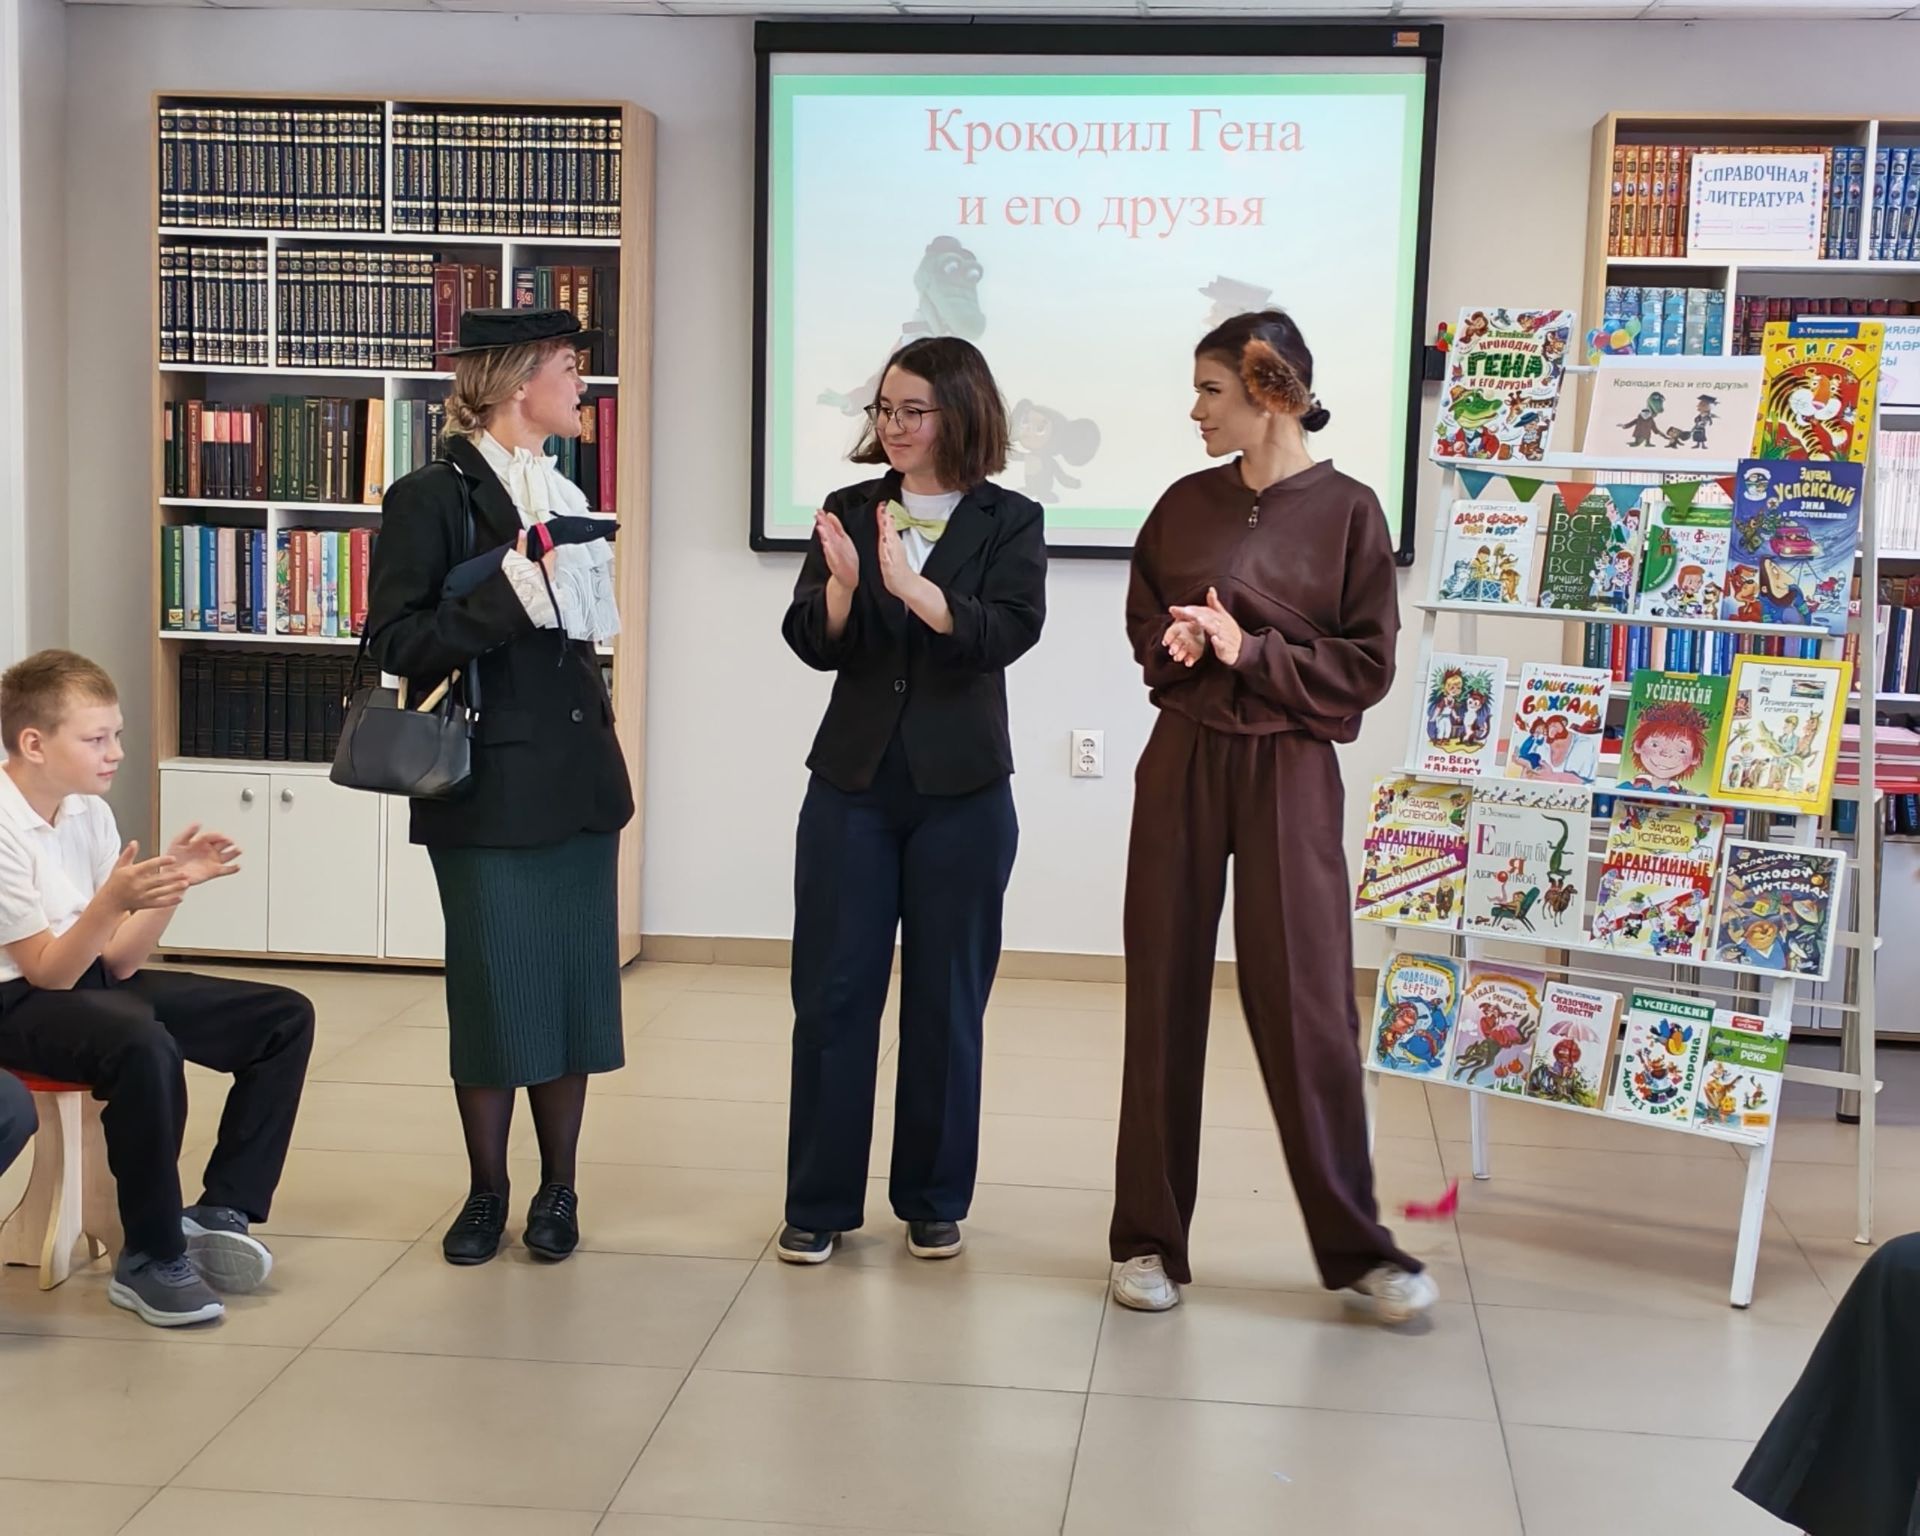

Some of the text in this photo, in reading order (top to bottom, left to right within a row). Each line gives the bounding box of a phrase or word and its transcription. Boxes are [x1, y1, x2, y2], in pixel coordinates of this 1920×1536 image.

[924, 108, 1305, 164] Крокодил Гена
[1704, 165, 1809, 183] СПРАВОЧНАЯ
[1704, 190, 1805, 207] ЛИТЕРАТУРА
[958, 196, 1267, 238] и его друзья
[1479, 340, 1540, 353] КРОКОДИЛ
[1787, 343, 1854, 358] ТИГР
[1467, 351, 1544, 378] ГЕНА
[1470, 379, 1533, 390] И ЕГО ДРУЗЬЯ
[1613, 379, 1661, 388] Крокодил
[1696, 382, 1711, 390] его
[1773, 482, 1856, 507] УСПЕНСКИЙ
[1800, 501, 1825, 510] ЗИМА
[1547, 574, 1584, 584] ЛУЧШИЕ
[1527, 678, 1605, 696] ВОЛШЕБНИК
[1645, 682, 1713, 705] УСПЕНСКИЙ
[1522, 695, 1599, 718] БАХРАМ
[1428, 755, 1480, 766] ПРО ВЕРУ
[1433, 763, 1482, 775] АНФИСУ
[1398, 808, 1447, 822] УСПЕНСКИЙ
[1372, 827, 1466, 849] ГАРАНТИЙНЫЕ
[1637, 833, 1689, 847] УСПЕНСКИЙ
[1378, 842, 1442, 858] ЧЕЛОВЕЧКИ
[1610, 850, 1711, 877] ГАРАНТИЙНЫЕ
[1368, 853, 1457, 898] ВОЗВРАЩАЮТСЯ
[1621, 868, 1695, 889] ЧЕЛОВЕЧКИ
[1741, 866, 1814, 884] МЕХОВОЙ
[1752, 881, 1829, 899] ИНТЕРНАТ
[1403, 982, 1438, 996] БЕРЕТЫ
[1471, 985, 1495, 1002] ИВАН
[1740, 1050, 1767, 1064] реке
[1623, 1068, 1646, 1110] МОЖЕТ
